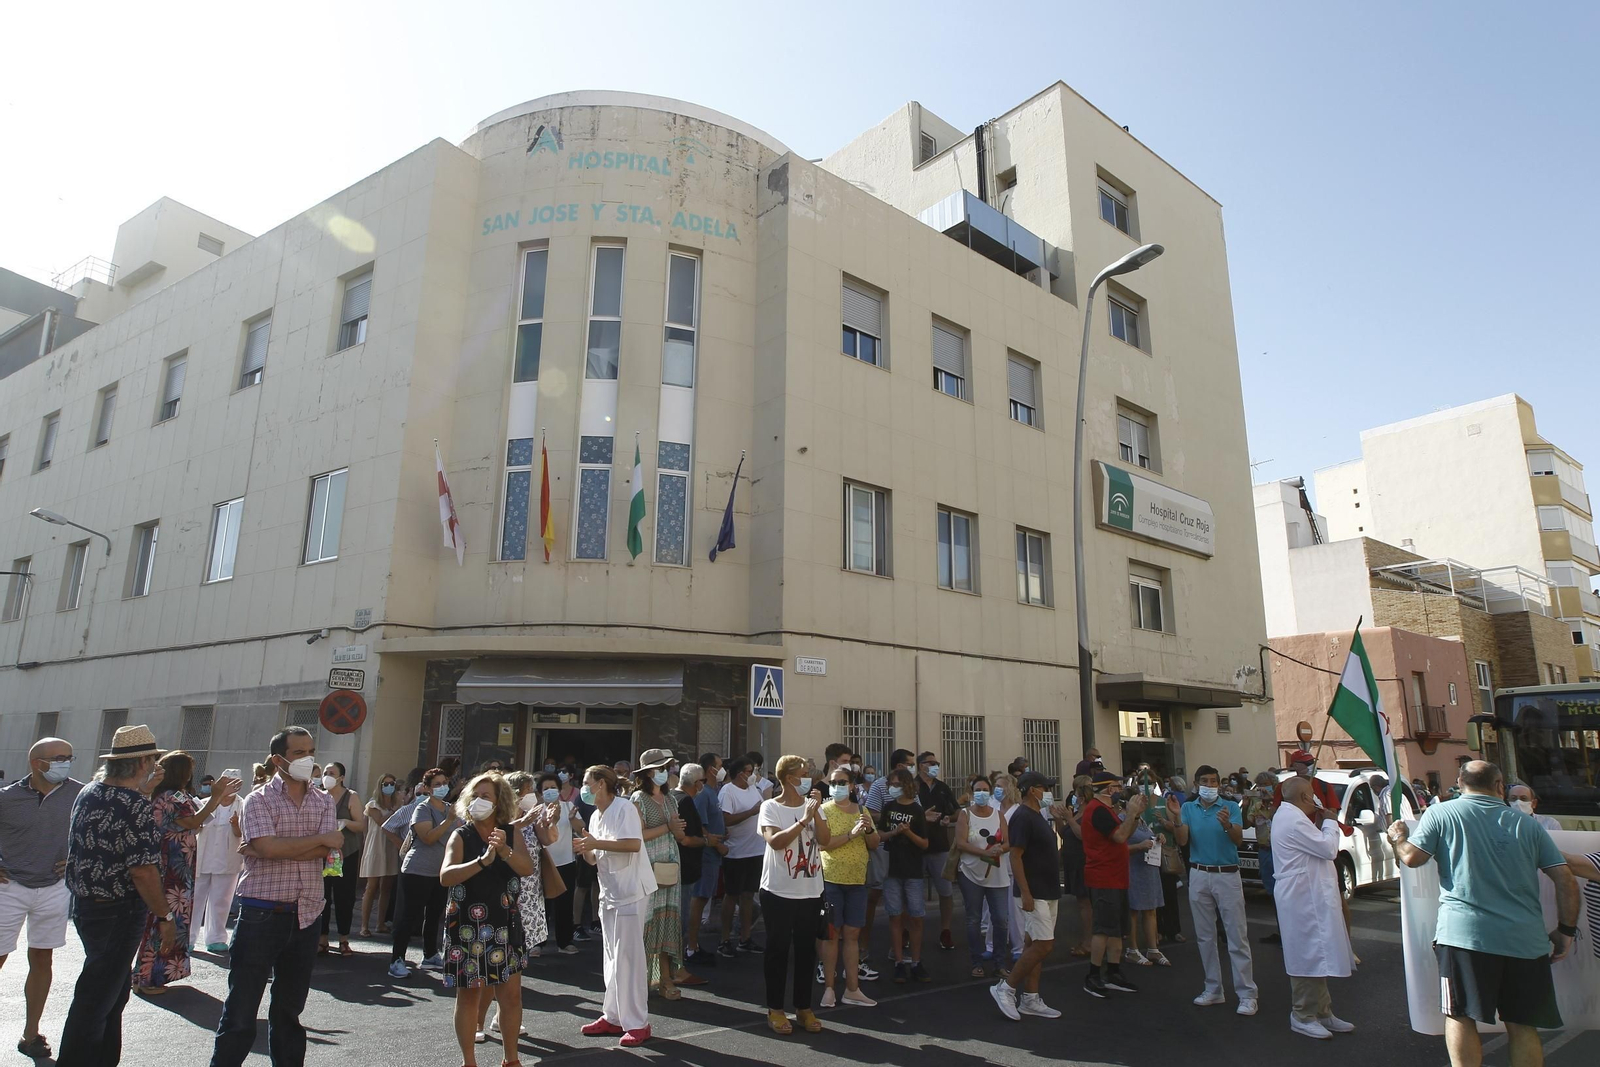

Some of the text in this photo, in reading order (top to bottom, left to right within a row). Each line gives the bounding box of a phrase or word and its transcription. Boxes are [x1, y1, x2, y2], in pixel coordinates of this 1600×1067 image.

[568, 151, 672, 177] HOSPITAL
[481, 203, 739, 240] SAN JOSE Y STA. ADELA
[1150, 502, 1210, 534] Hospital Cruz Roja
[890, 811, 913, 823] FIGHT
